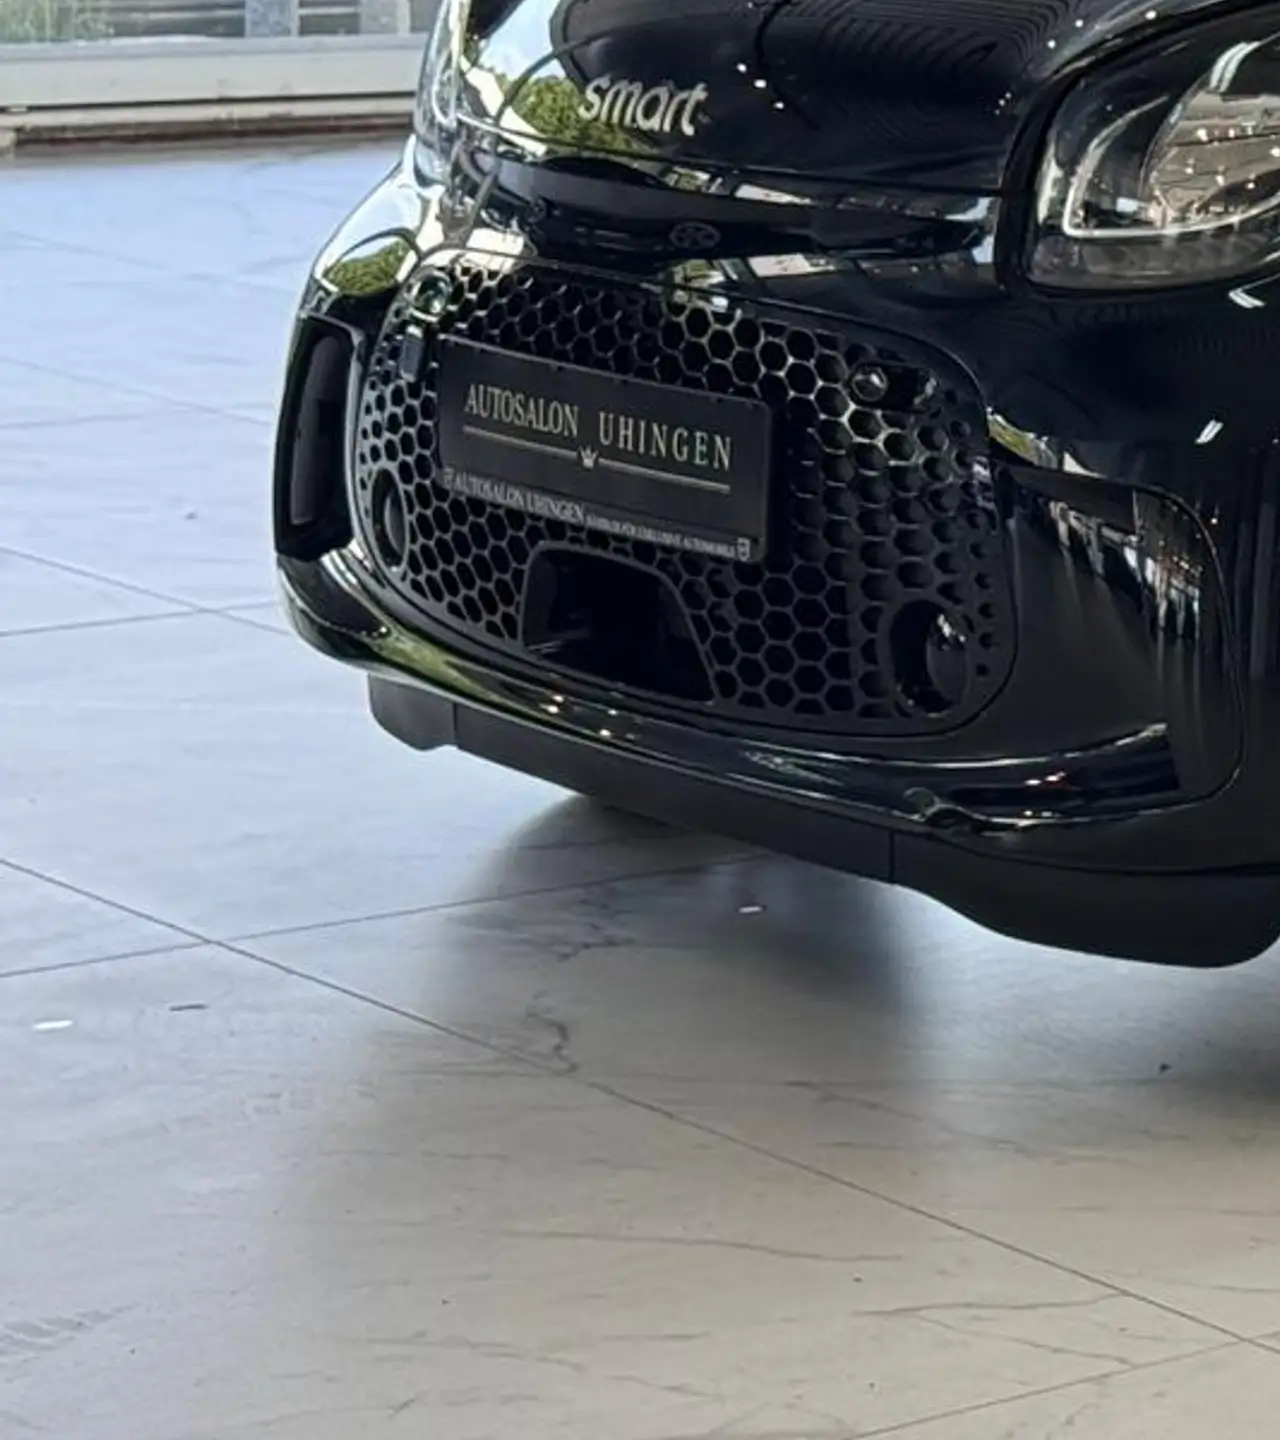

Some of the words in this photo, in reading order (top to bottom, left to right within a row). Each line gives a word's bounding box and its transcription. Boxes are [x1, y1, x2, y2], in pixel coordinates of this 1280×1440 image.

[578, 74, 709, 136] smart
[464, 383, 580, 438] AUTOSALON
[599, 411, 732, 471] UHINGEN
